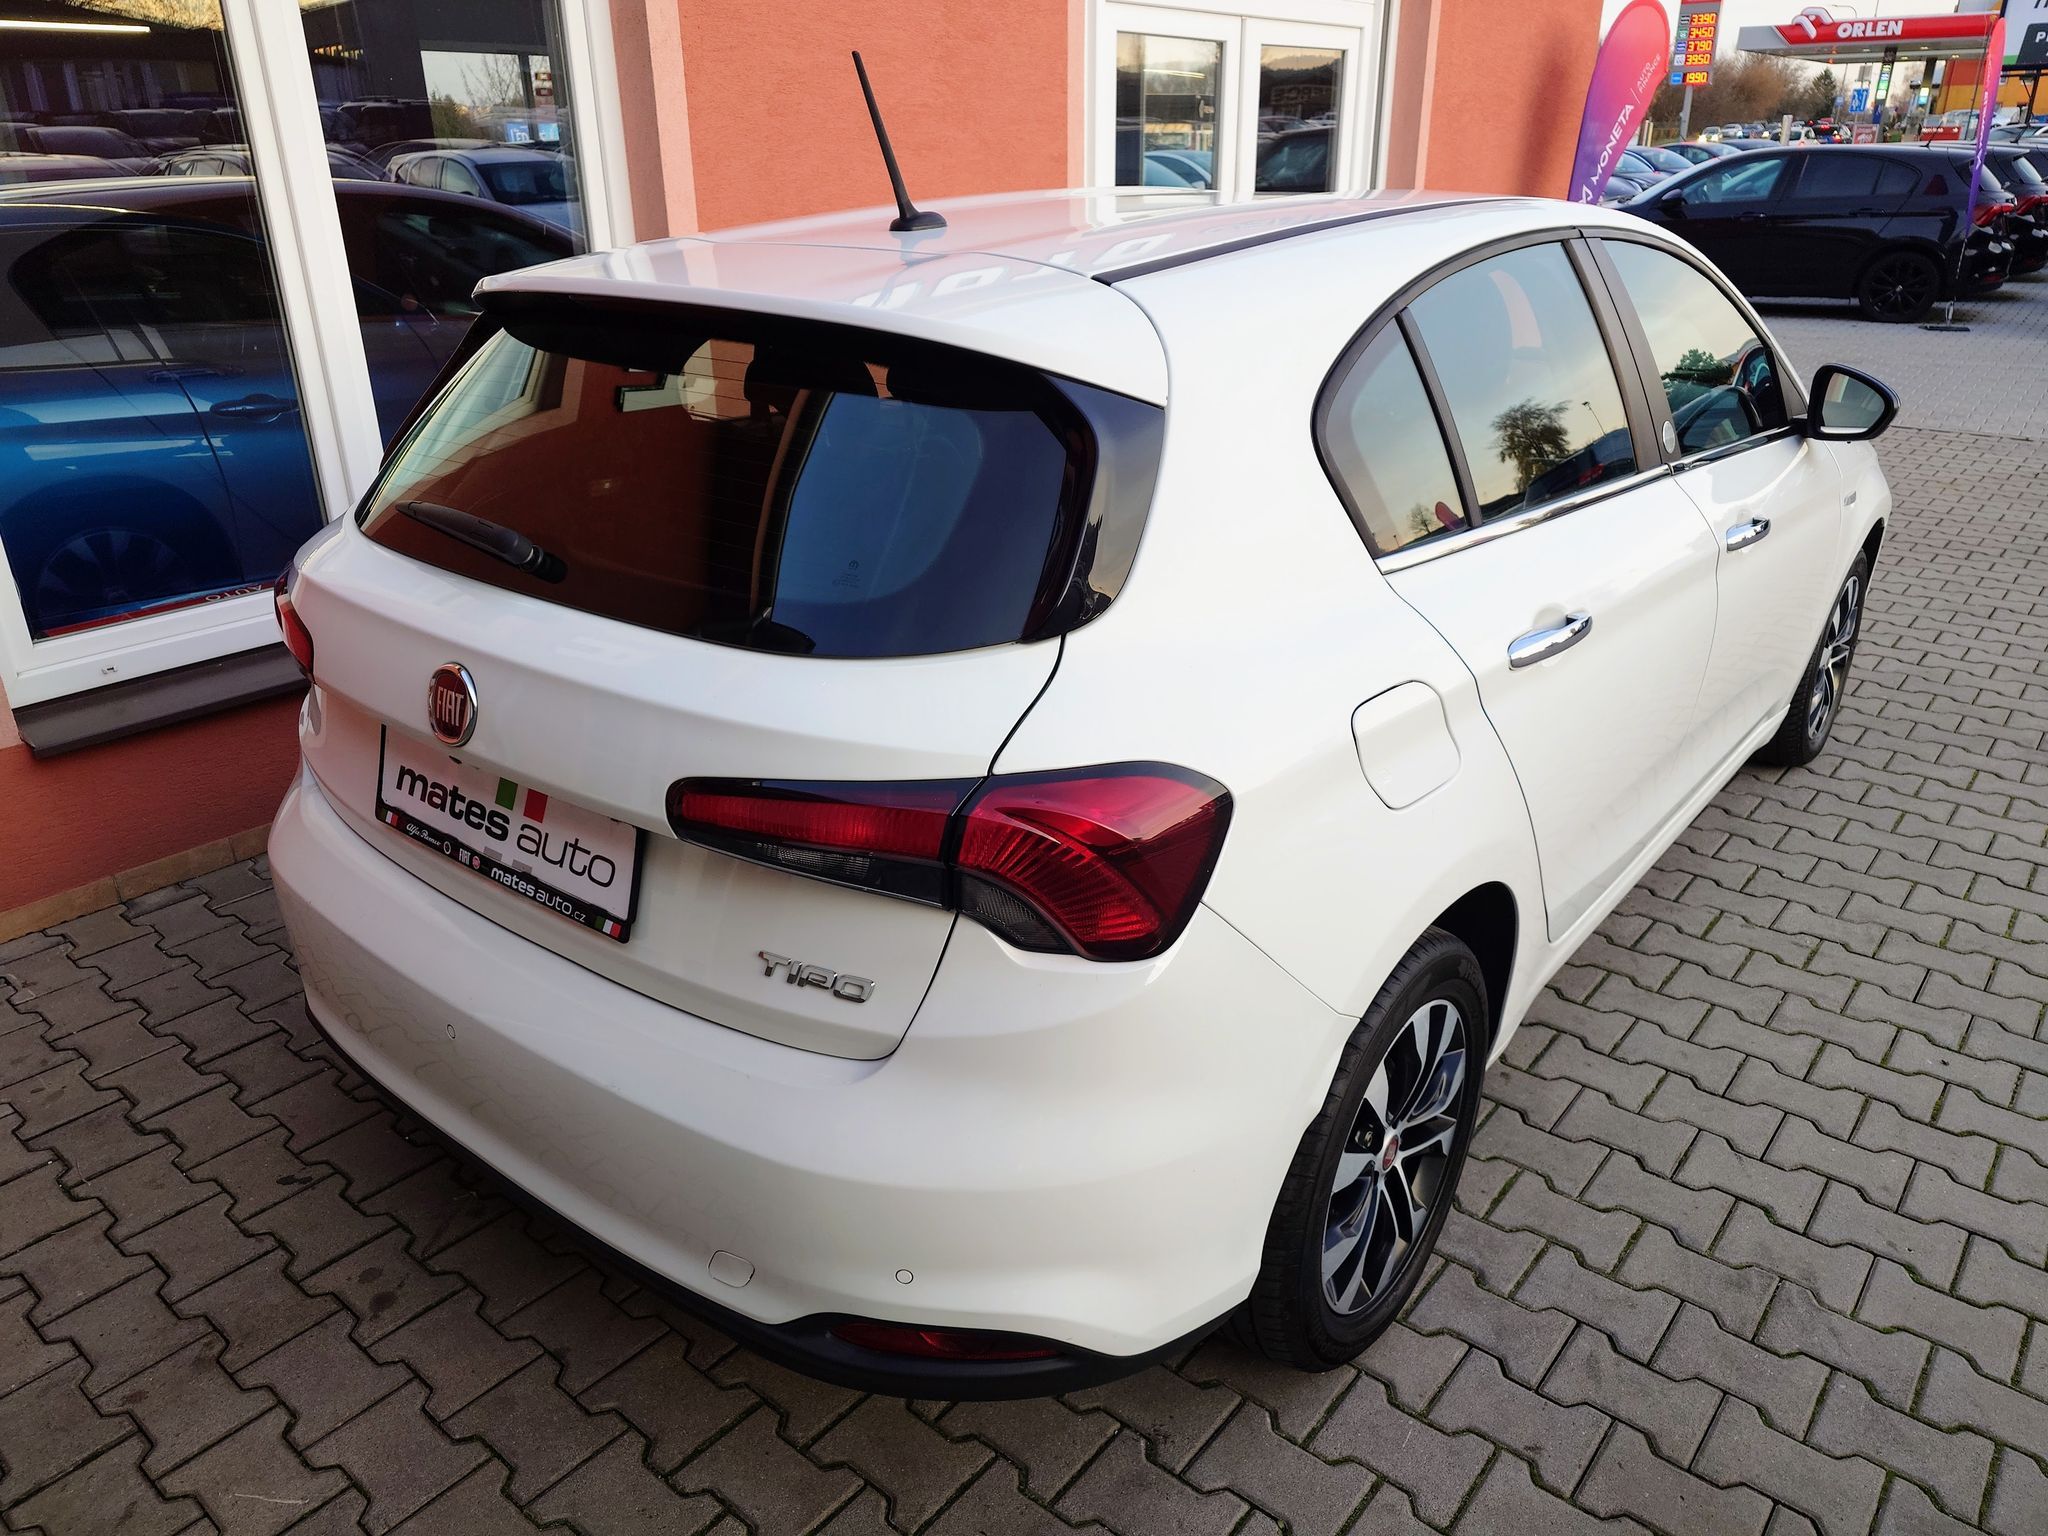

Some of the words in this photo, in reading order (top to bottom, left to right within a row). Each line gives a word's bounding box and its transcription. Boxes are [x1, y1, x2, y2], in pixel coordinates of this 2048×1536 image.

[1837, 20, 1904, 38] ORLEN
[1639, 53, 1661, 94] FINANCE
[1590, 103, 1635, 185] MONETA
[436, 686, 465, 727] FIAT
[395, 764, 510, 842] mates
[516, 823, 616, 888] auto
[406, 822, 420, 836] Alfa
[458, 847, 471, 866] FIAT
[758, 950, 876, 1004] TIPO
